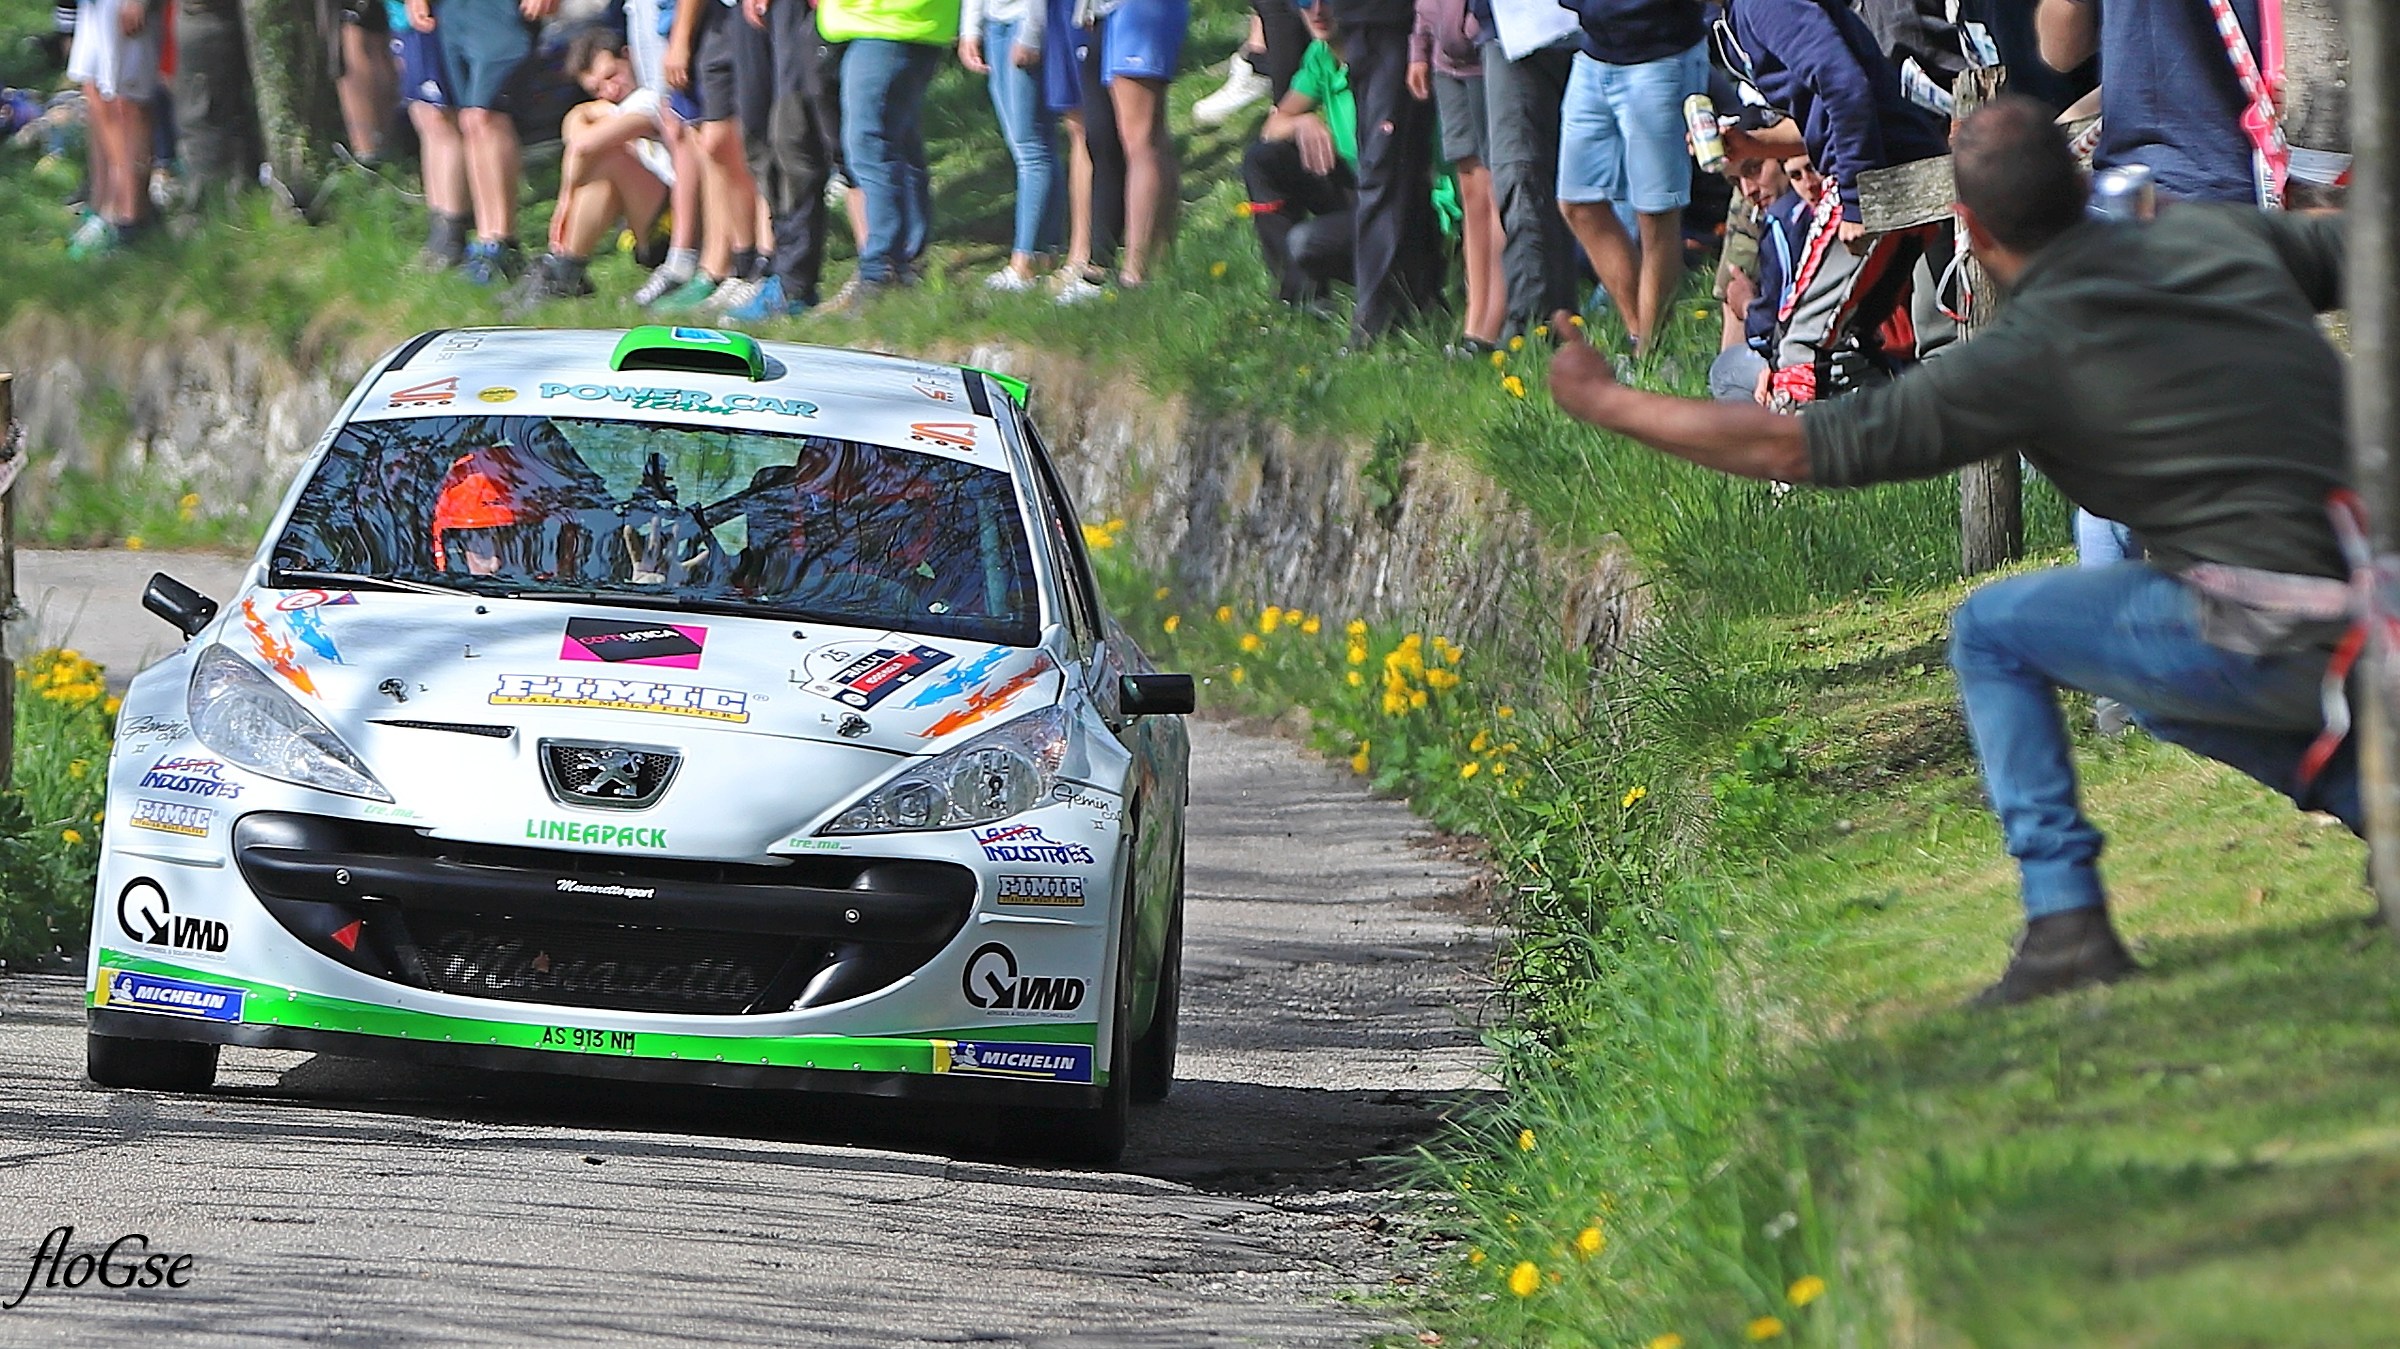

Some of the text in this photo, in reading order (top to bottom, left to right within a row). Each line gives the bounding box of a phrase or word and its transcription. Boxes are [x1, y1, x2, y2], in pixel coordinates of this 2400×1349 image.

[541, 383, 712, 406] POWER
[722, 394, 819, 419] CAR
[820, 648, 851, 662] 25
[497, 674, 747, 715] FIMIC
[506, 694, 732, 720] ITALIAN MELT FILTER
[152, 754, 225, 782] LASER
[140, 771, 245, 799] INDUSTRIES
[133, 799, 214, 830] FIMIC
[363, 804, 415, 818] tre.ma
[526, 818, 667, 849] LINEAPACK
[789, 838, 841, 849] tre.ma
[970, 824, 1062, 845] LASER
[981, 842, 1095, 865] INDUSTRIES
[998, 874, 1083, 898] FIMIC
[135, 986, 226, 1009] MICHELIN
[542, 1026, 636, 1050] AS 913 NM
[981, 1051, 1075, 1070] MICHELIN
